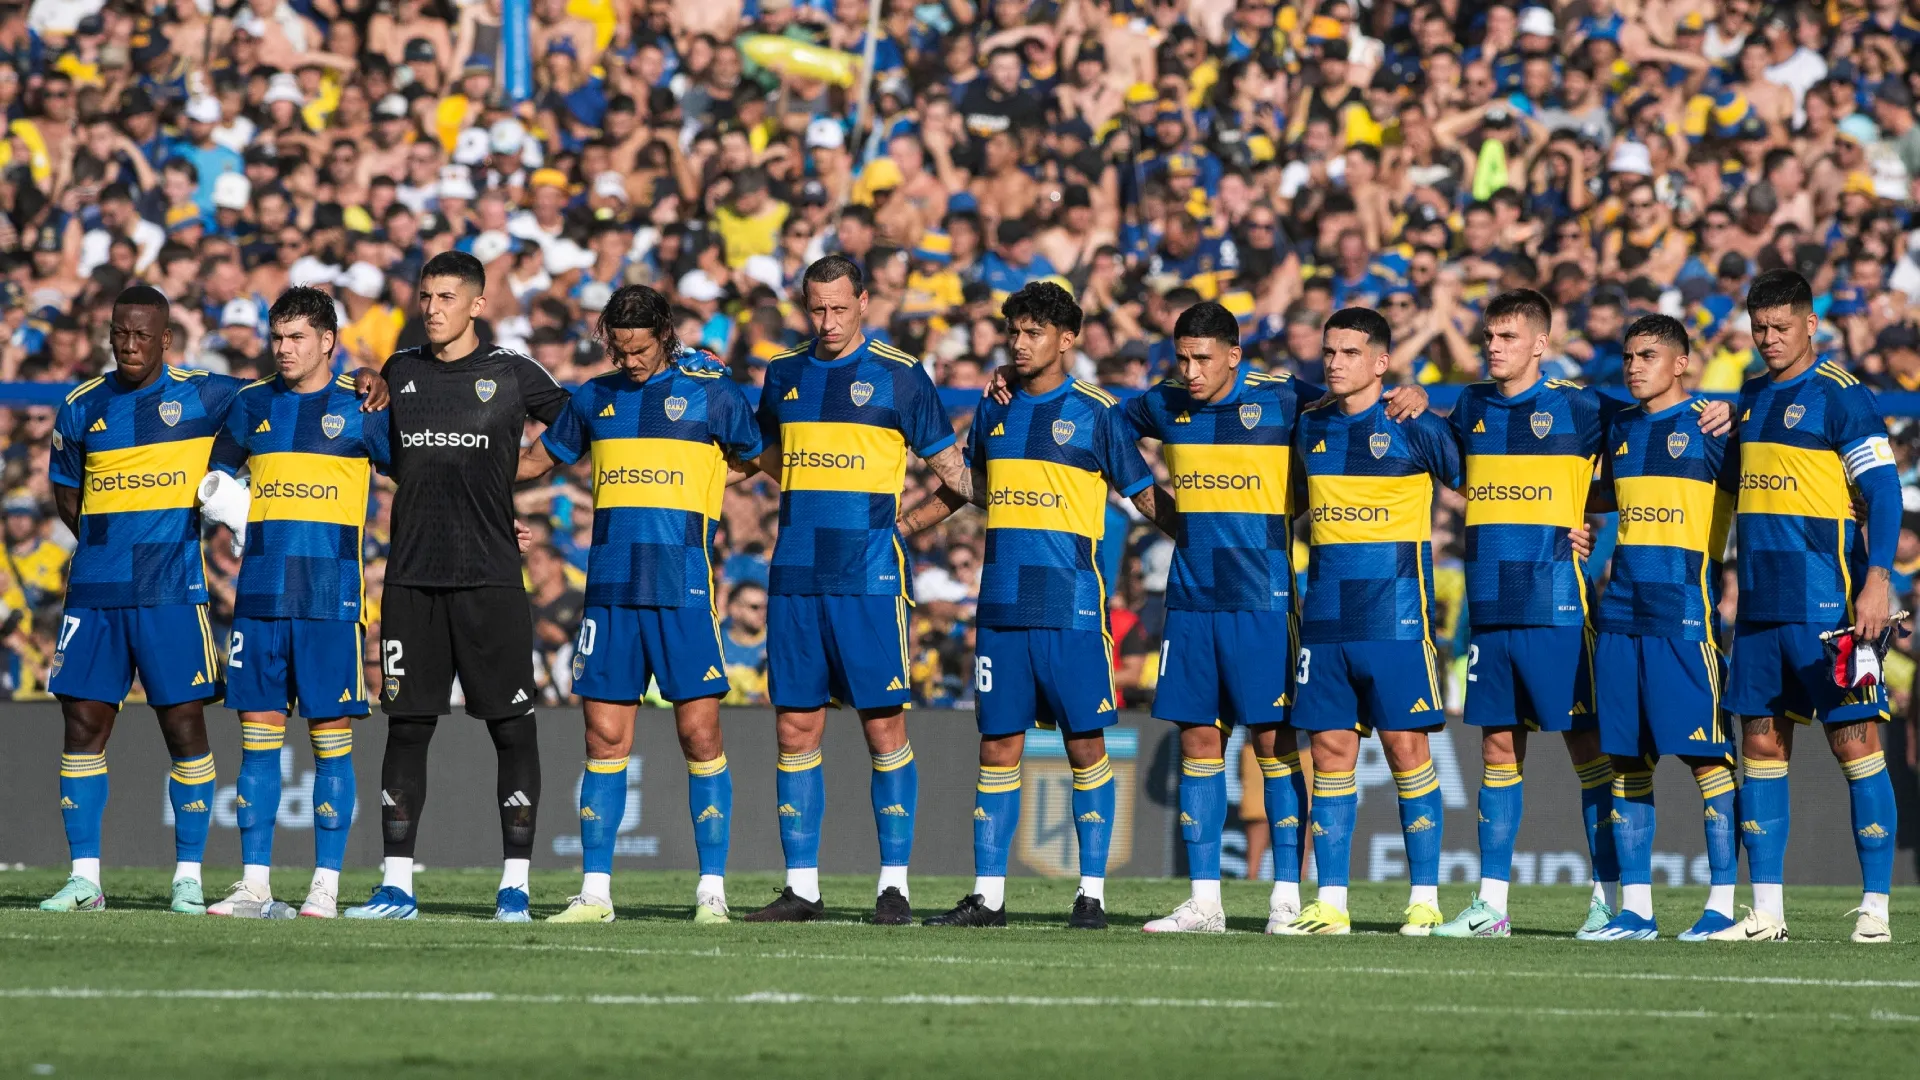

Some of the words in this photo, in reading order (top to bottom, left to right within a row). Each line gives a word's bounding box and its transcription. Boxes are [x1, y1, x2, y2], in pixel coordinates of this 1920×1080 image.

[400, 429, 489, 450] betsson
[91, 469, 186, 493] betsson
[1739, 470, 1797, 492] etsson
[1618, 504, 1684, 524] etsson
[229, 630, 244, 668] 2
[382, 639, 407, 675] 12
